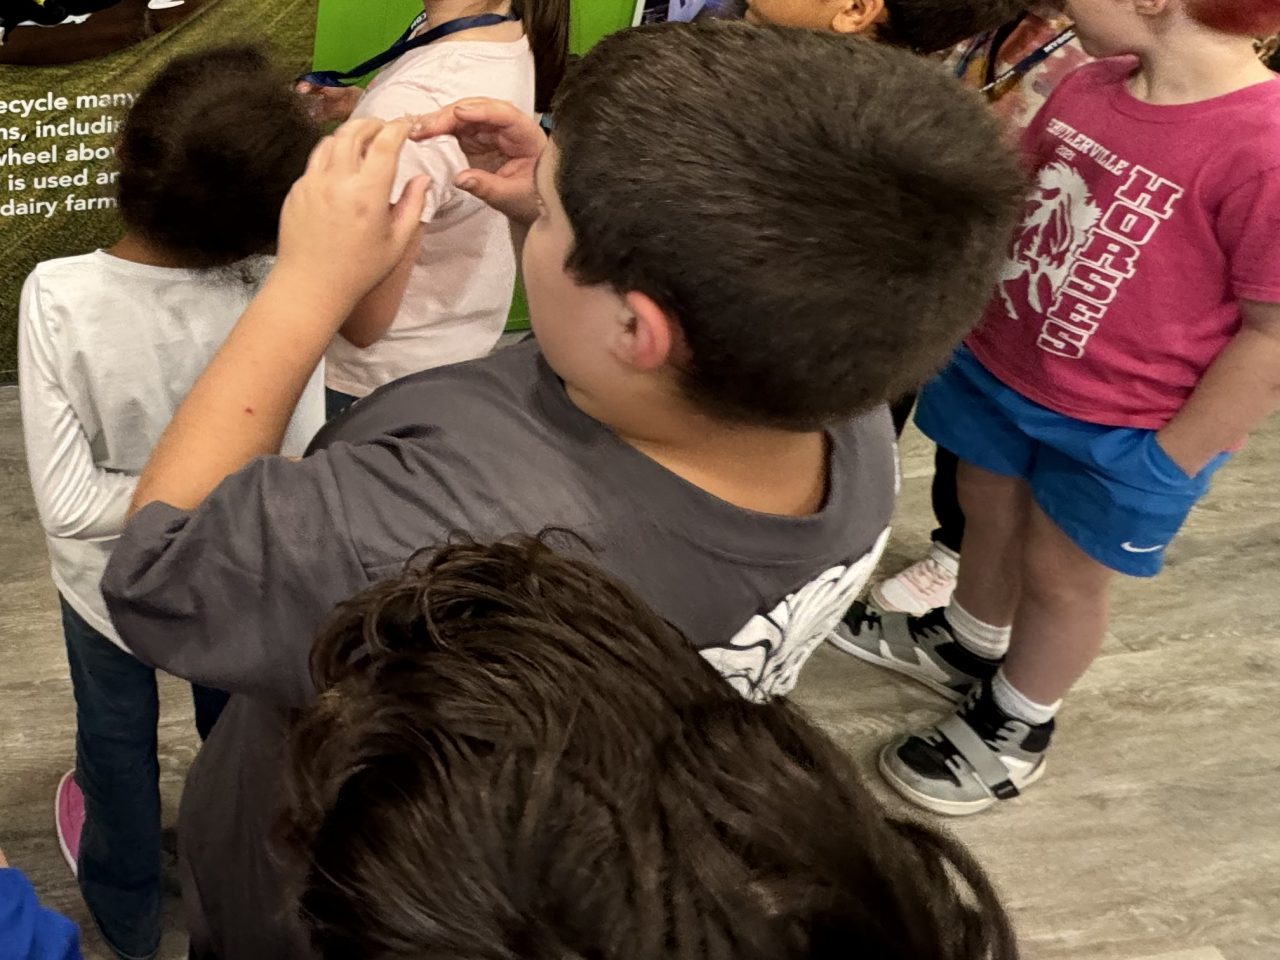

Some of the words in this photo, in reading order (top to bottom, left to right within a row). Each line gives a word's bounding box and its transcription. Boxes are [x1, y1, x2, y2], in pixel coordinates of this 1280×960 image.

[77, 93, 139, 109] many
[8, 174, 25, 191] is
[34, 168, 88, 189] used
[0, 198, 57, 218] dairy
[1036, 165, 1184, 359] HORSES
